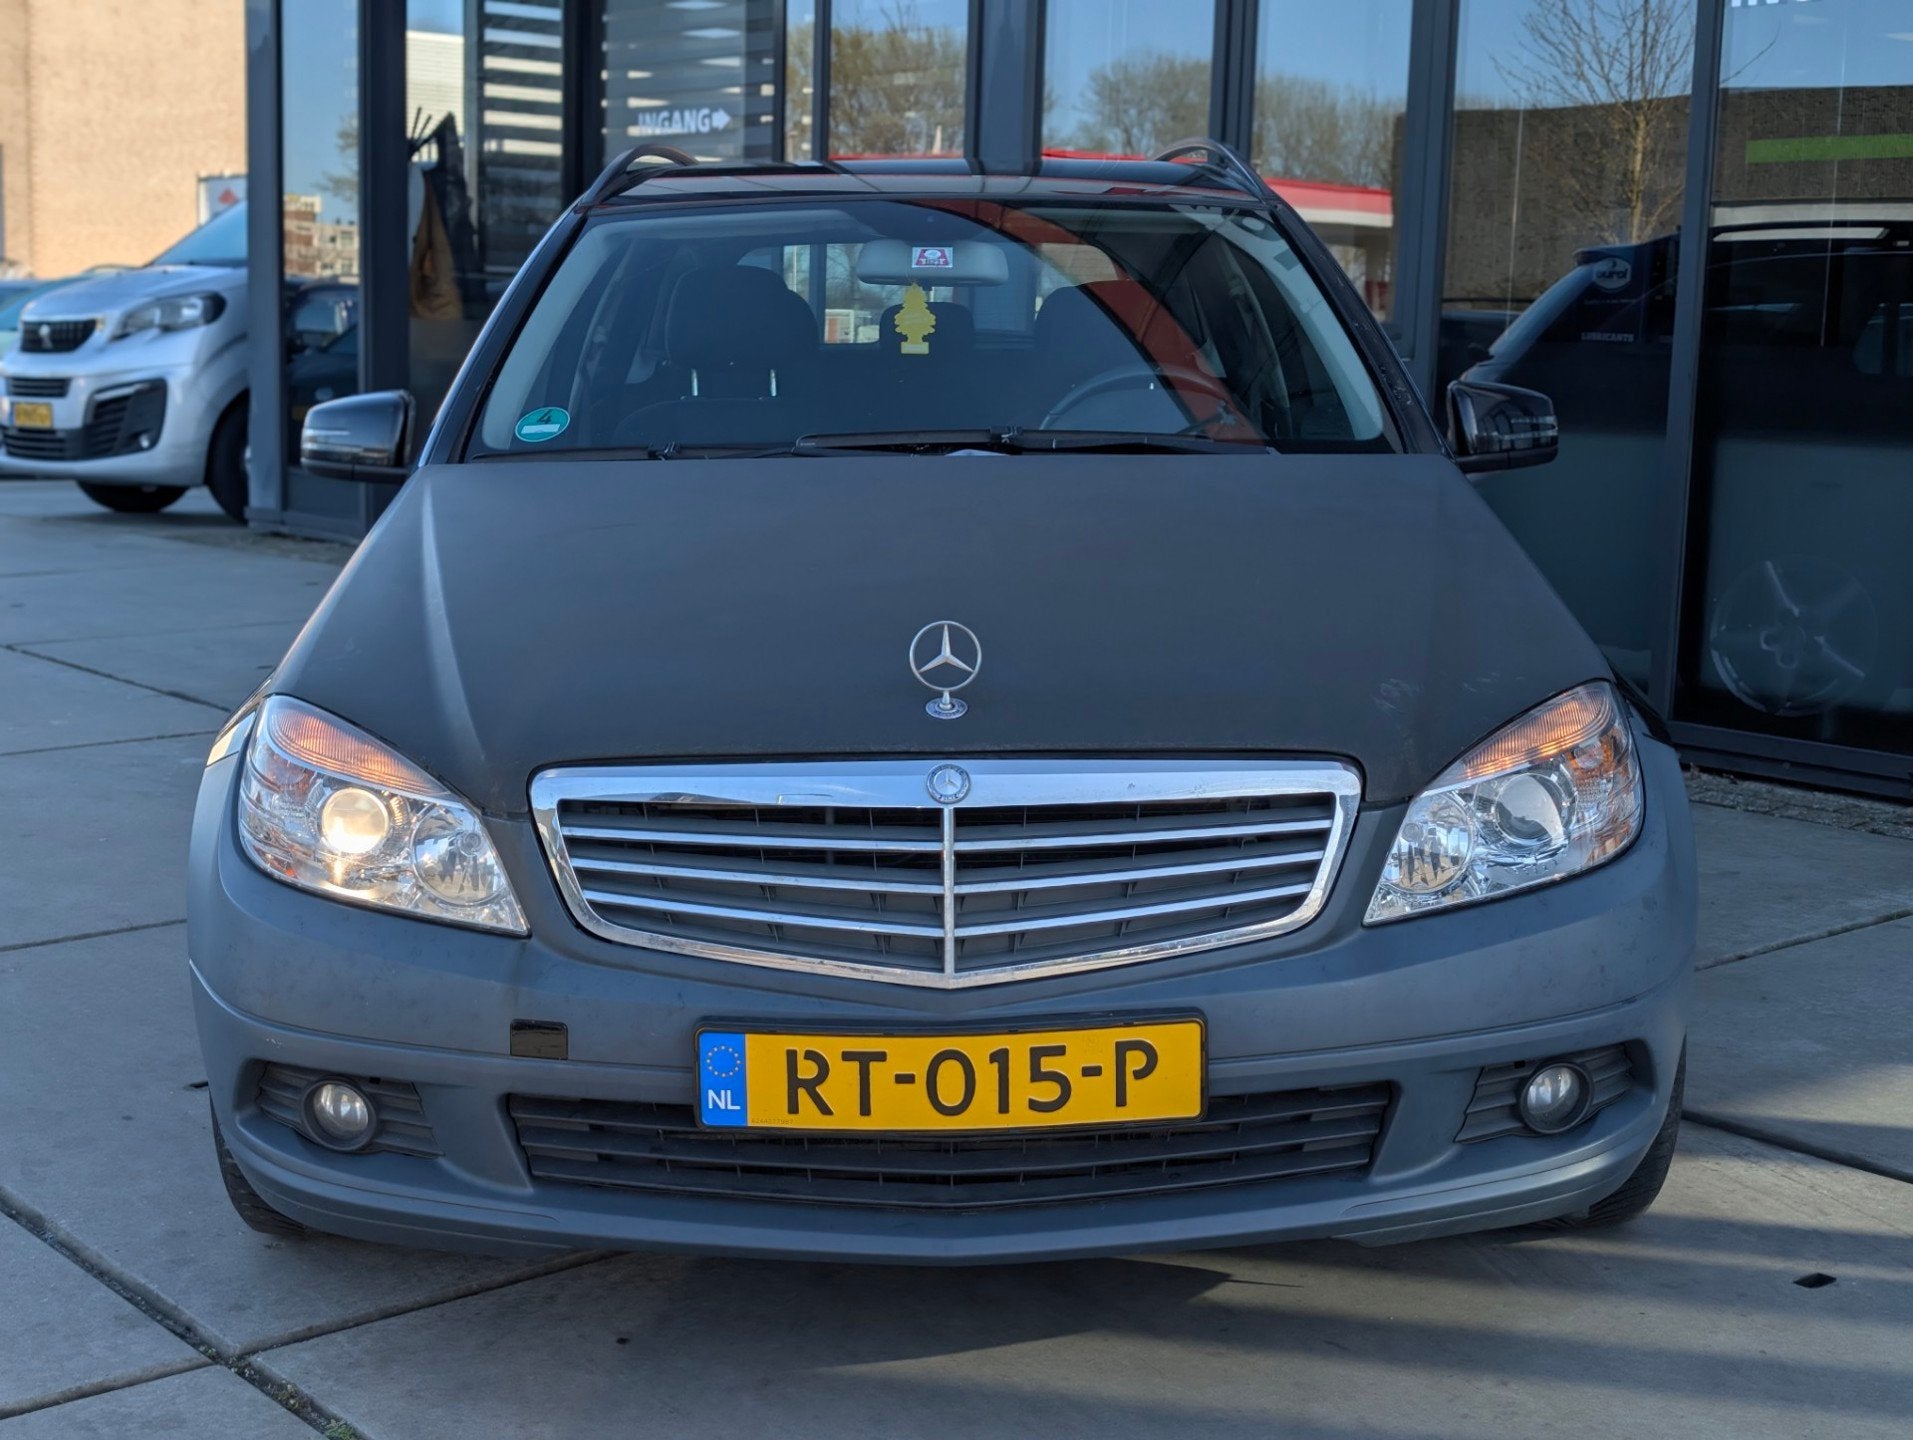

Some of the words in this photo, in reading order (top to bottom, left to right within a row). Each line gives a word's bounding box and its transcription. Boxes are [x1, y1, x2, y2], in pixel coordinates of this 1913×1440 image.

[638, 108, 712, 135] INGANG
[785, 1038, 1159, 1117] RT-015-P
[708, 1089, 741, 1110] NL
